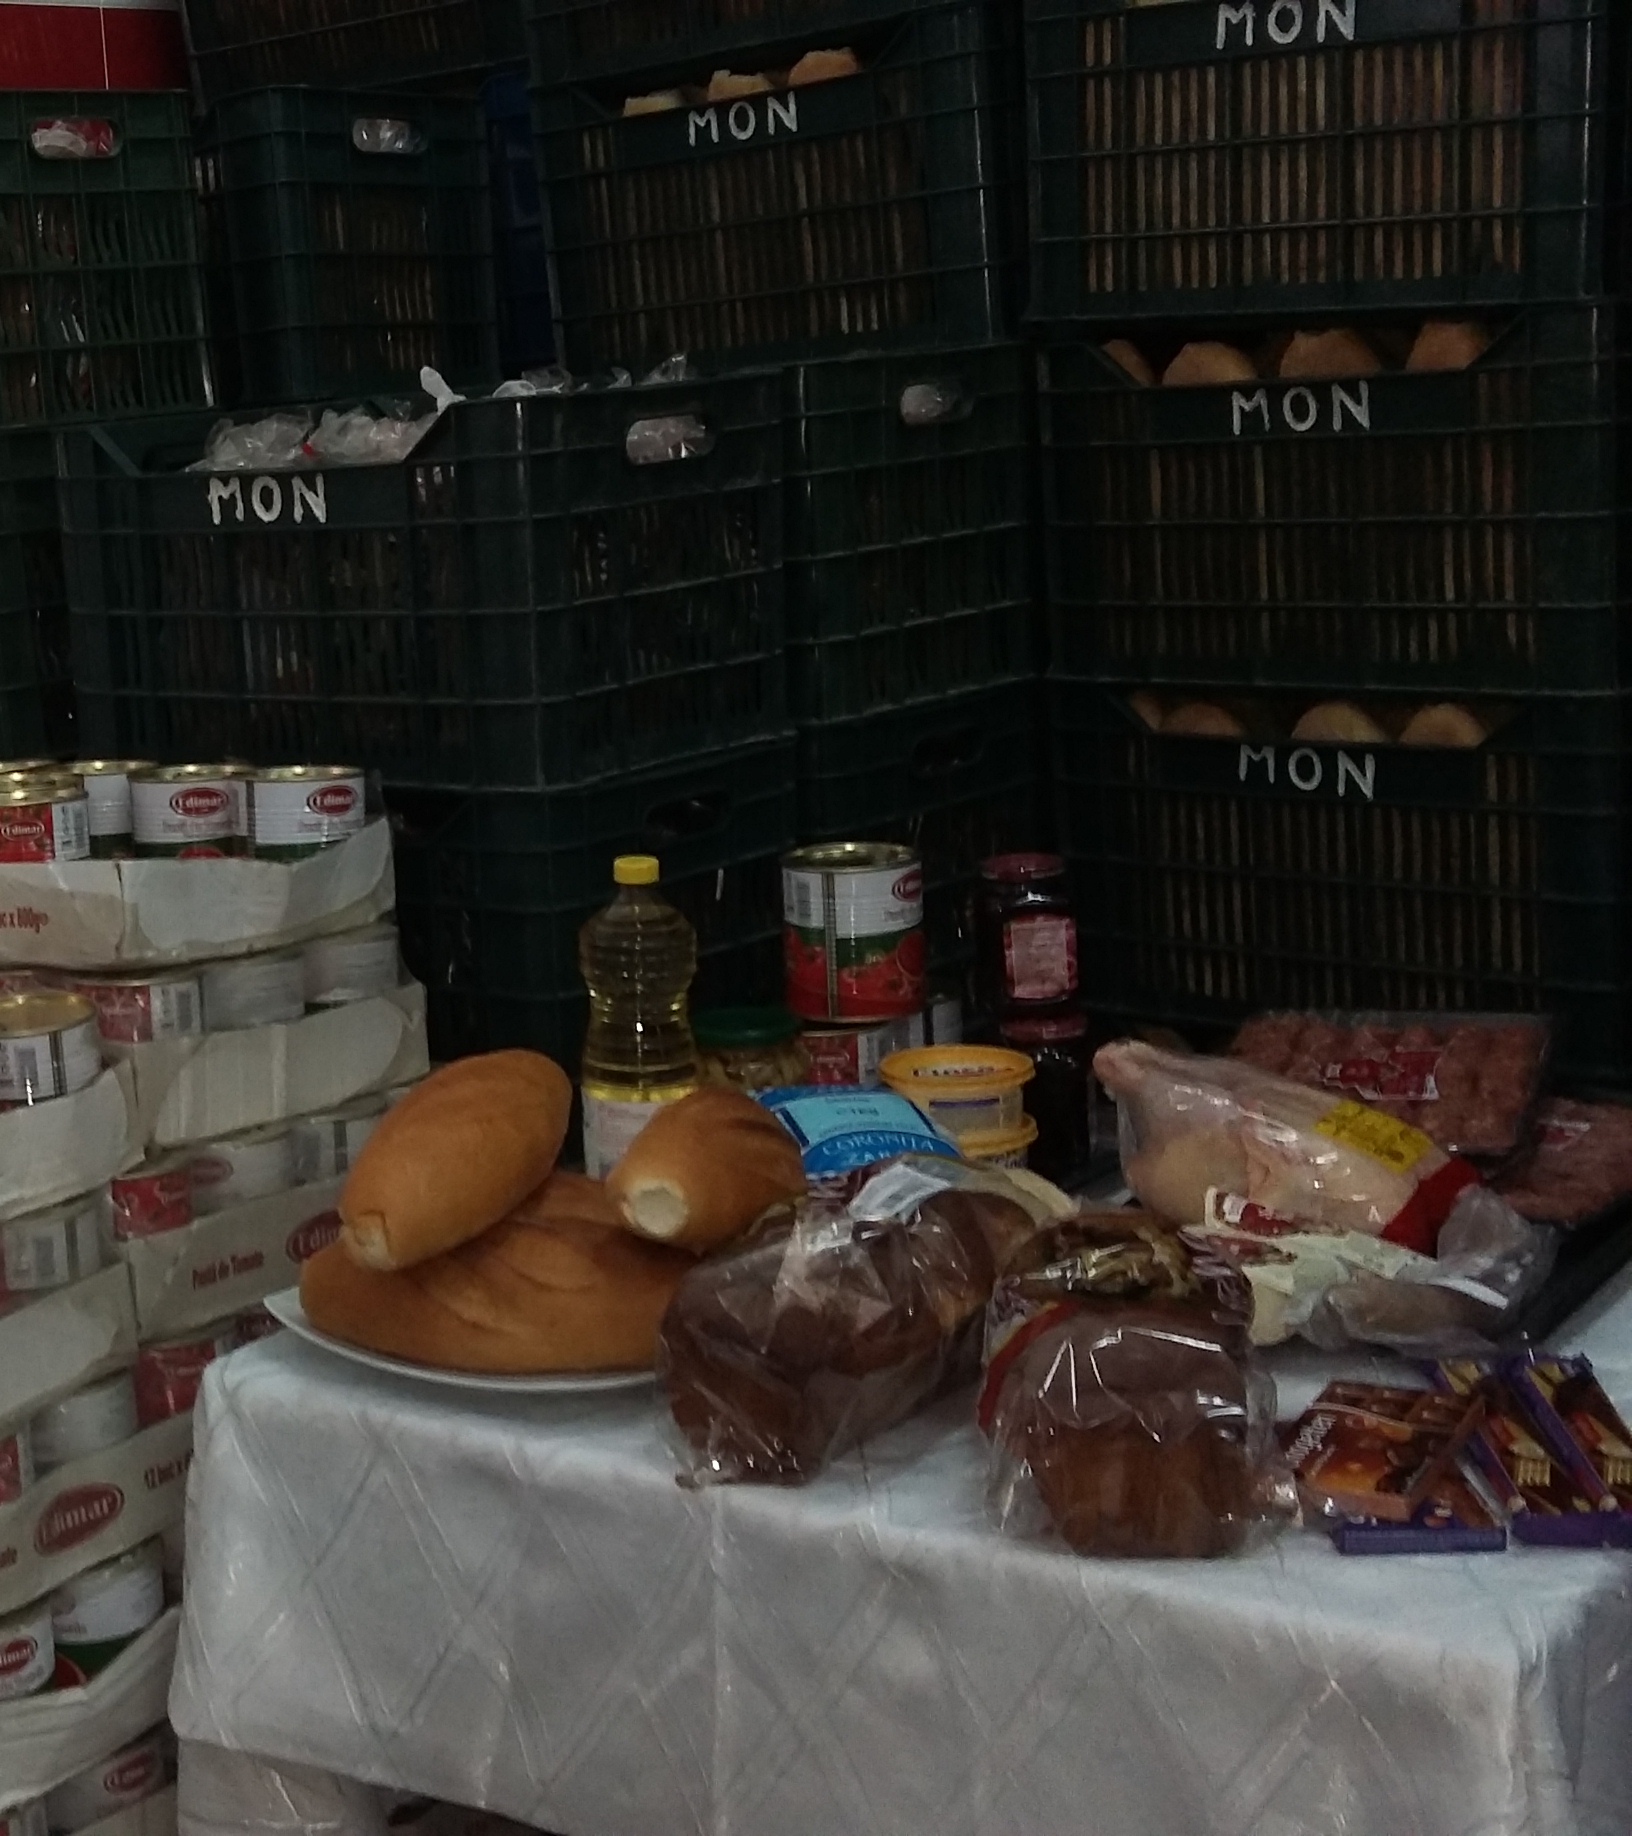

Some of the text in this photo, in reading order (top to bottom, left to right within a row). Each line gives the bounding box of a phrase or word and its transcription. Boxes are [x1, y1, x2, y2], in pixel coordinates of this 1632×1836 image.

[1216, 0, 1356, 50] MON
[688, 91, 798, 147] MON
[1231, 379, 1371, 436] MON
[208, 472, 327, 525] MON
[1238, 743, 1376, 801] MON
